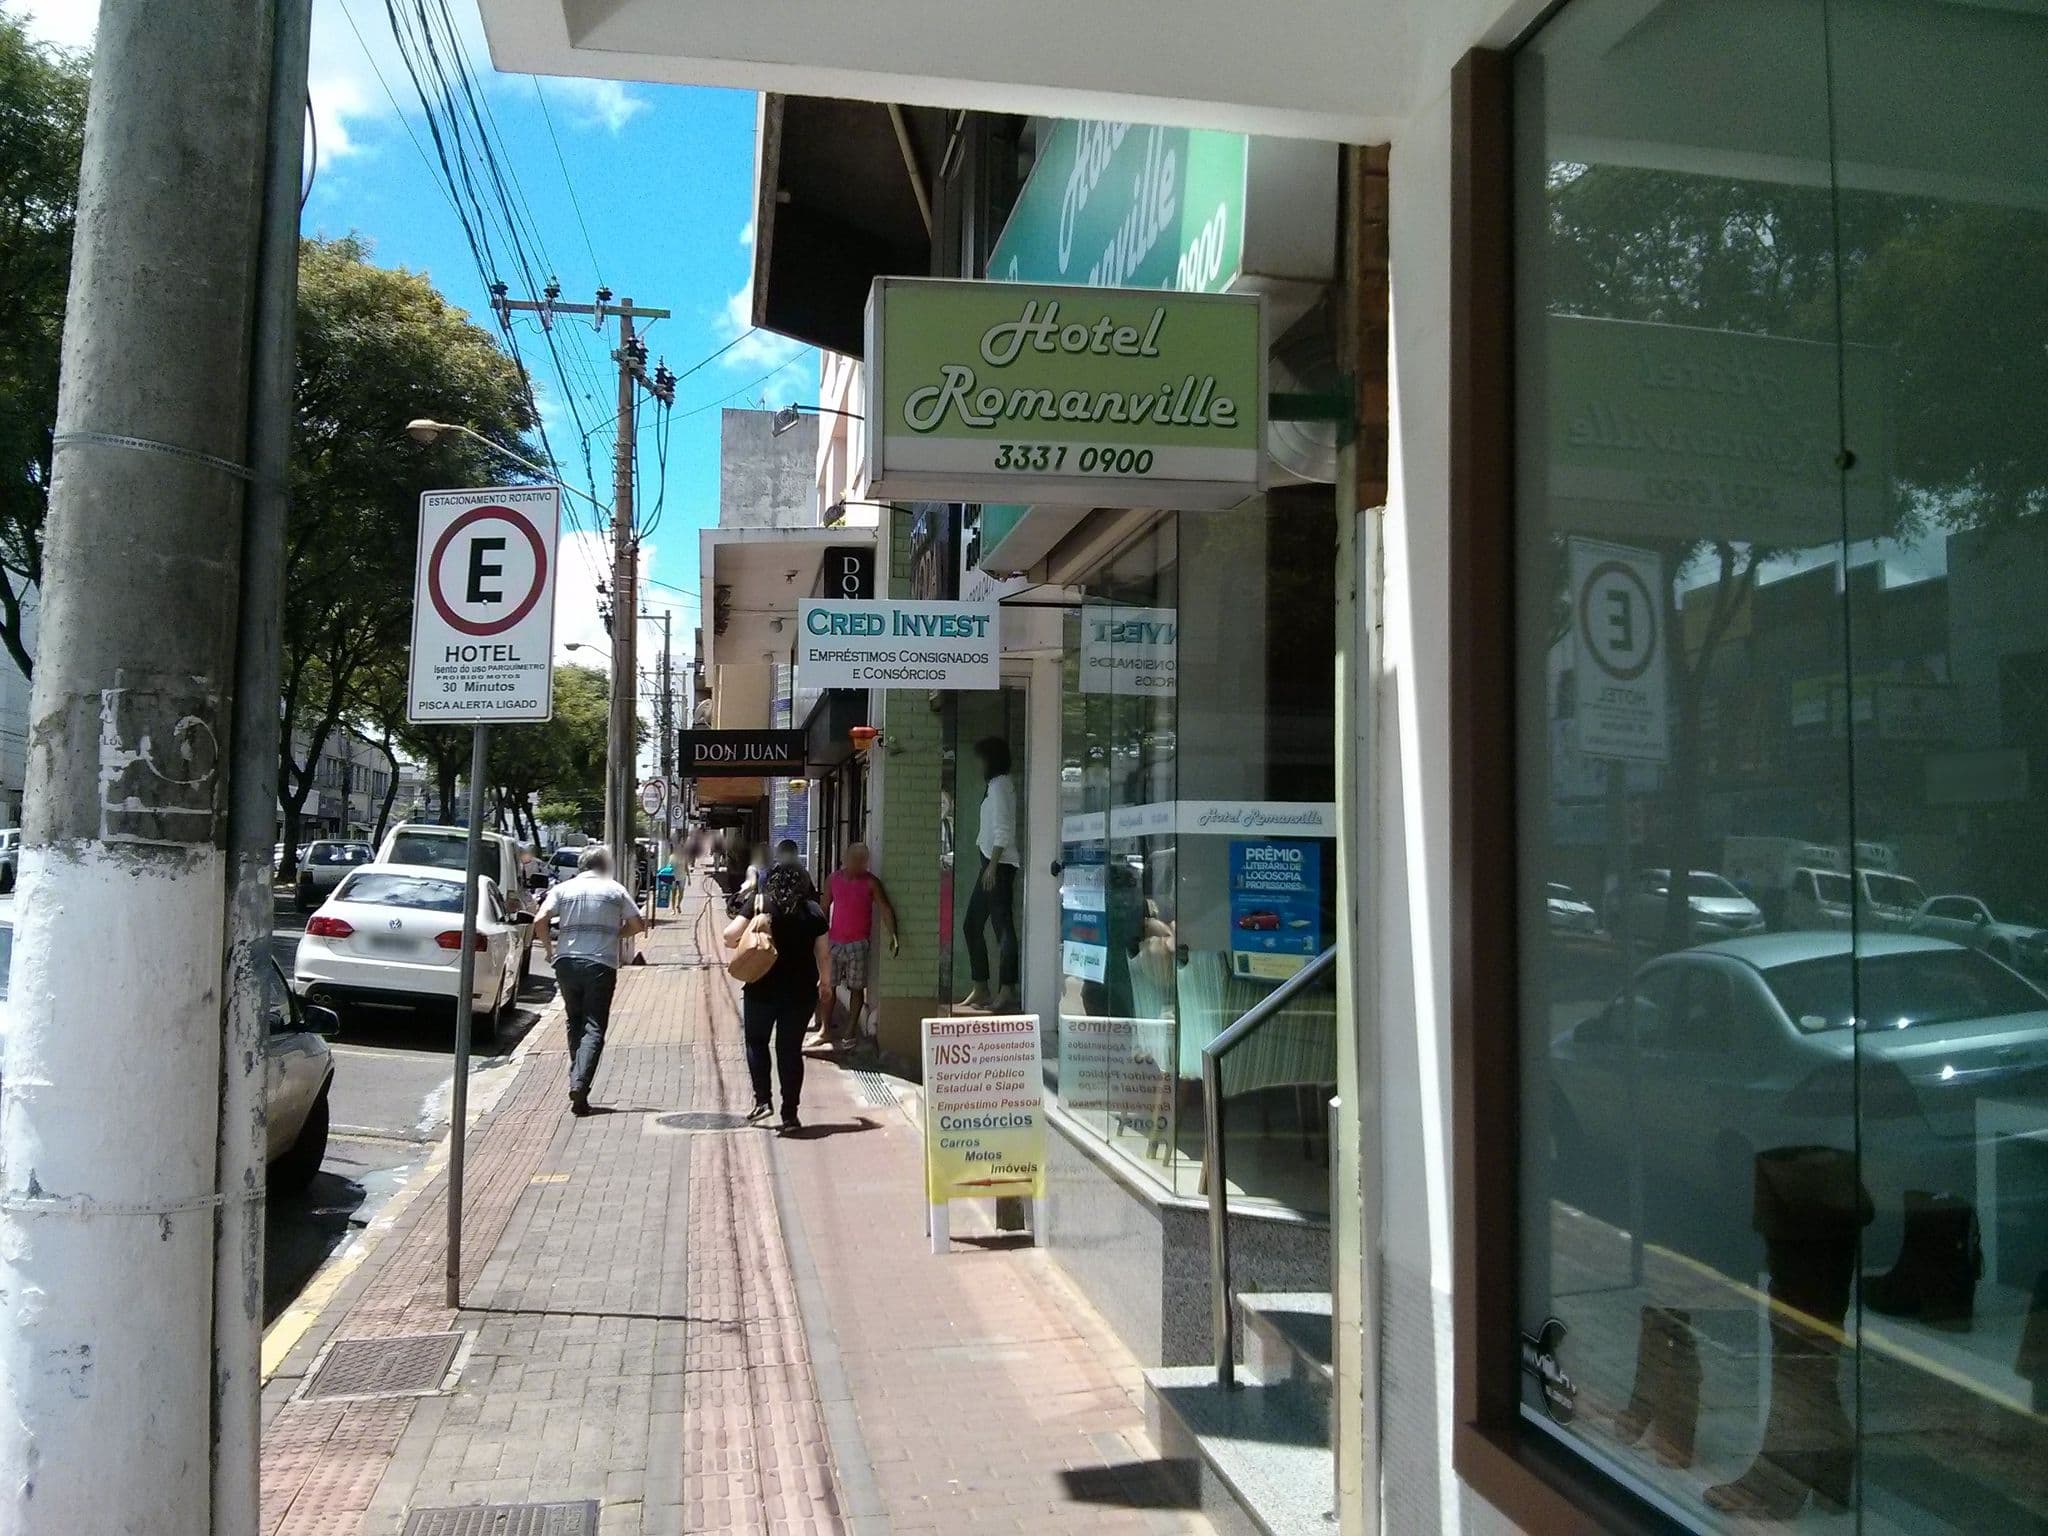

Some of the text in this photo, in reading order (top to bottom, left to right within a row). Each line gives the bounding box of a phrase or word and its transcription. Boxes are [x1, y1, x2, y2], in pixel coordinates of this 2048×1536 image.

[980, 300, 1165, 367] Hotel
[903, 364, 1239, 433] Romanville
[994, 444, 1154, 475] 3331 0900
[429, 492, 553, 507] ESTACIONAMENTO ROTATIVO
[466, 537, 507, 604] E
[806, 608, 991, 638] CRED INVEST
[445, 644, 521, 663] HOTEL
[809, 648, 989, 664] EMPRÉSTIMOS CONSIGNADOS
[433, 664, 458, 674] Isento
[460, 664, 470, 674] do
[472, 665, 487, 673] uso
[863, 666, 947, 681] CONSÓRCIOS
[442, 681, 516, 693] 30 Minutos
[418, 699, 538, 710] PISCA ALERTA LIGADO
[695, 743, 789, 762] DON JUAN
[1245, 845, 1303, 862] PRÊMIO
[1245, 871, 1302, 881] LOGOSOFIA
[930, 1020, 1035, 1038] Empréstimos
[935, 1040, 1036, 1066] INSS Aposentados
[979, 1053, 1036, 1065] pensionistas
[936, 1068, 1025, 1081] Servidor Público
[936, 1082, 983, 1094] Estadual
[995, 1080, 1025, 1092] Siape
[937, 1097, 1042, 1113] Empréstimo Pessoal
[940, 1112, 1033, 1130] Consórcios
[940, 1137, 981, 1149] Carros
[964, 1150, 1003, 1161] Motos
[991, 1161, 1039, 1175] Imóveis
